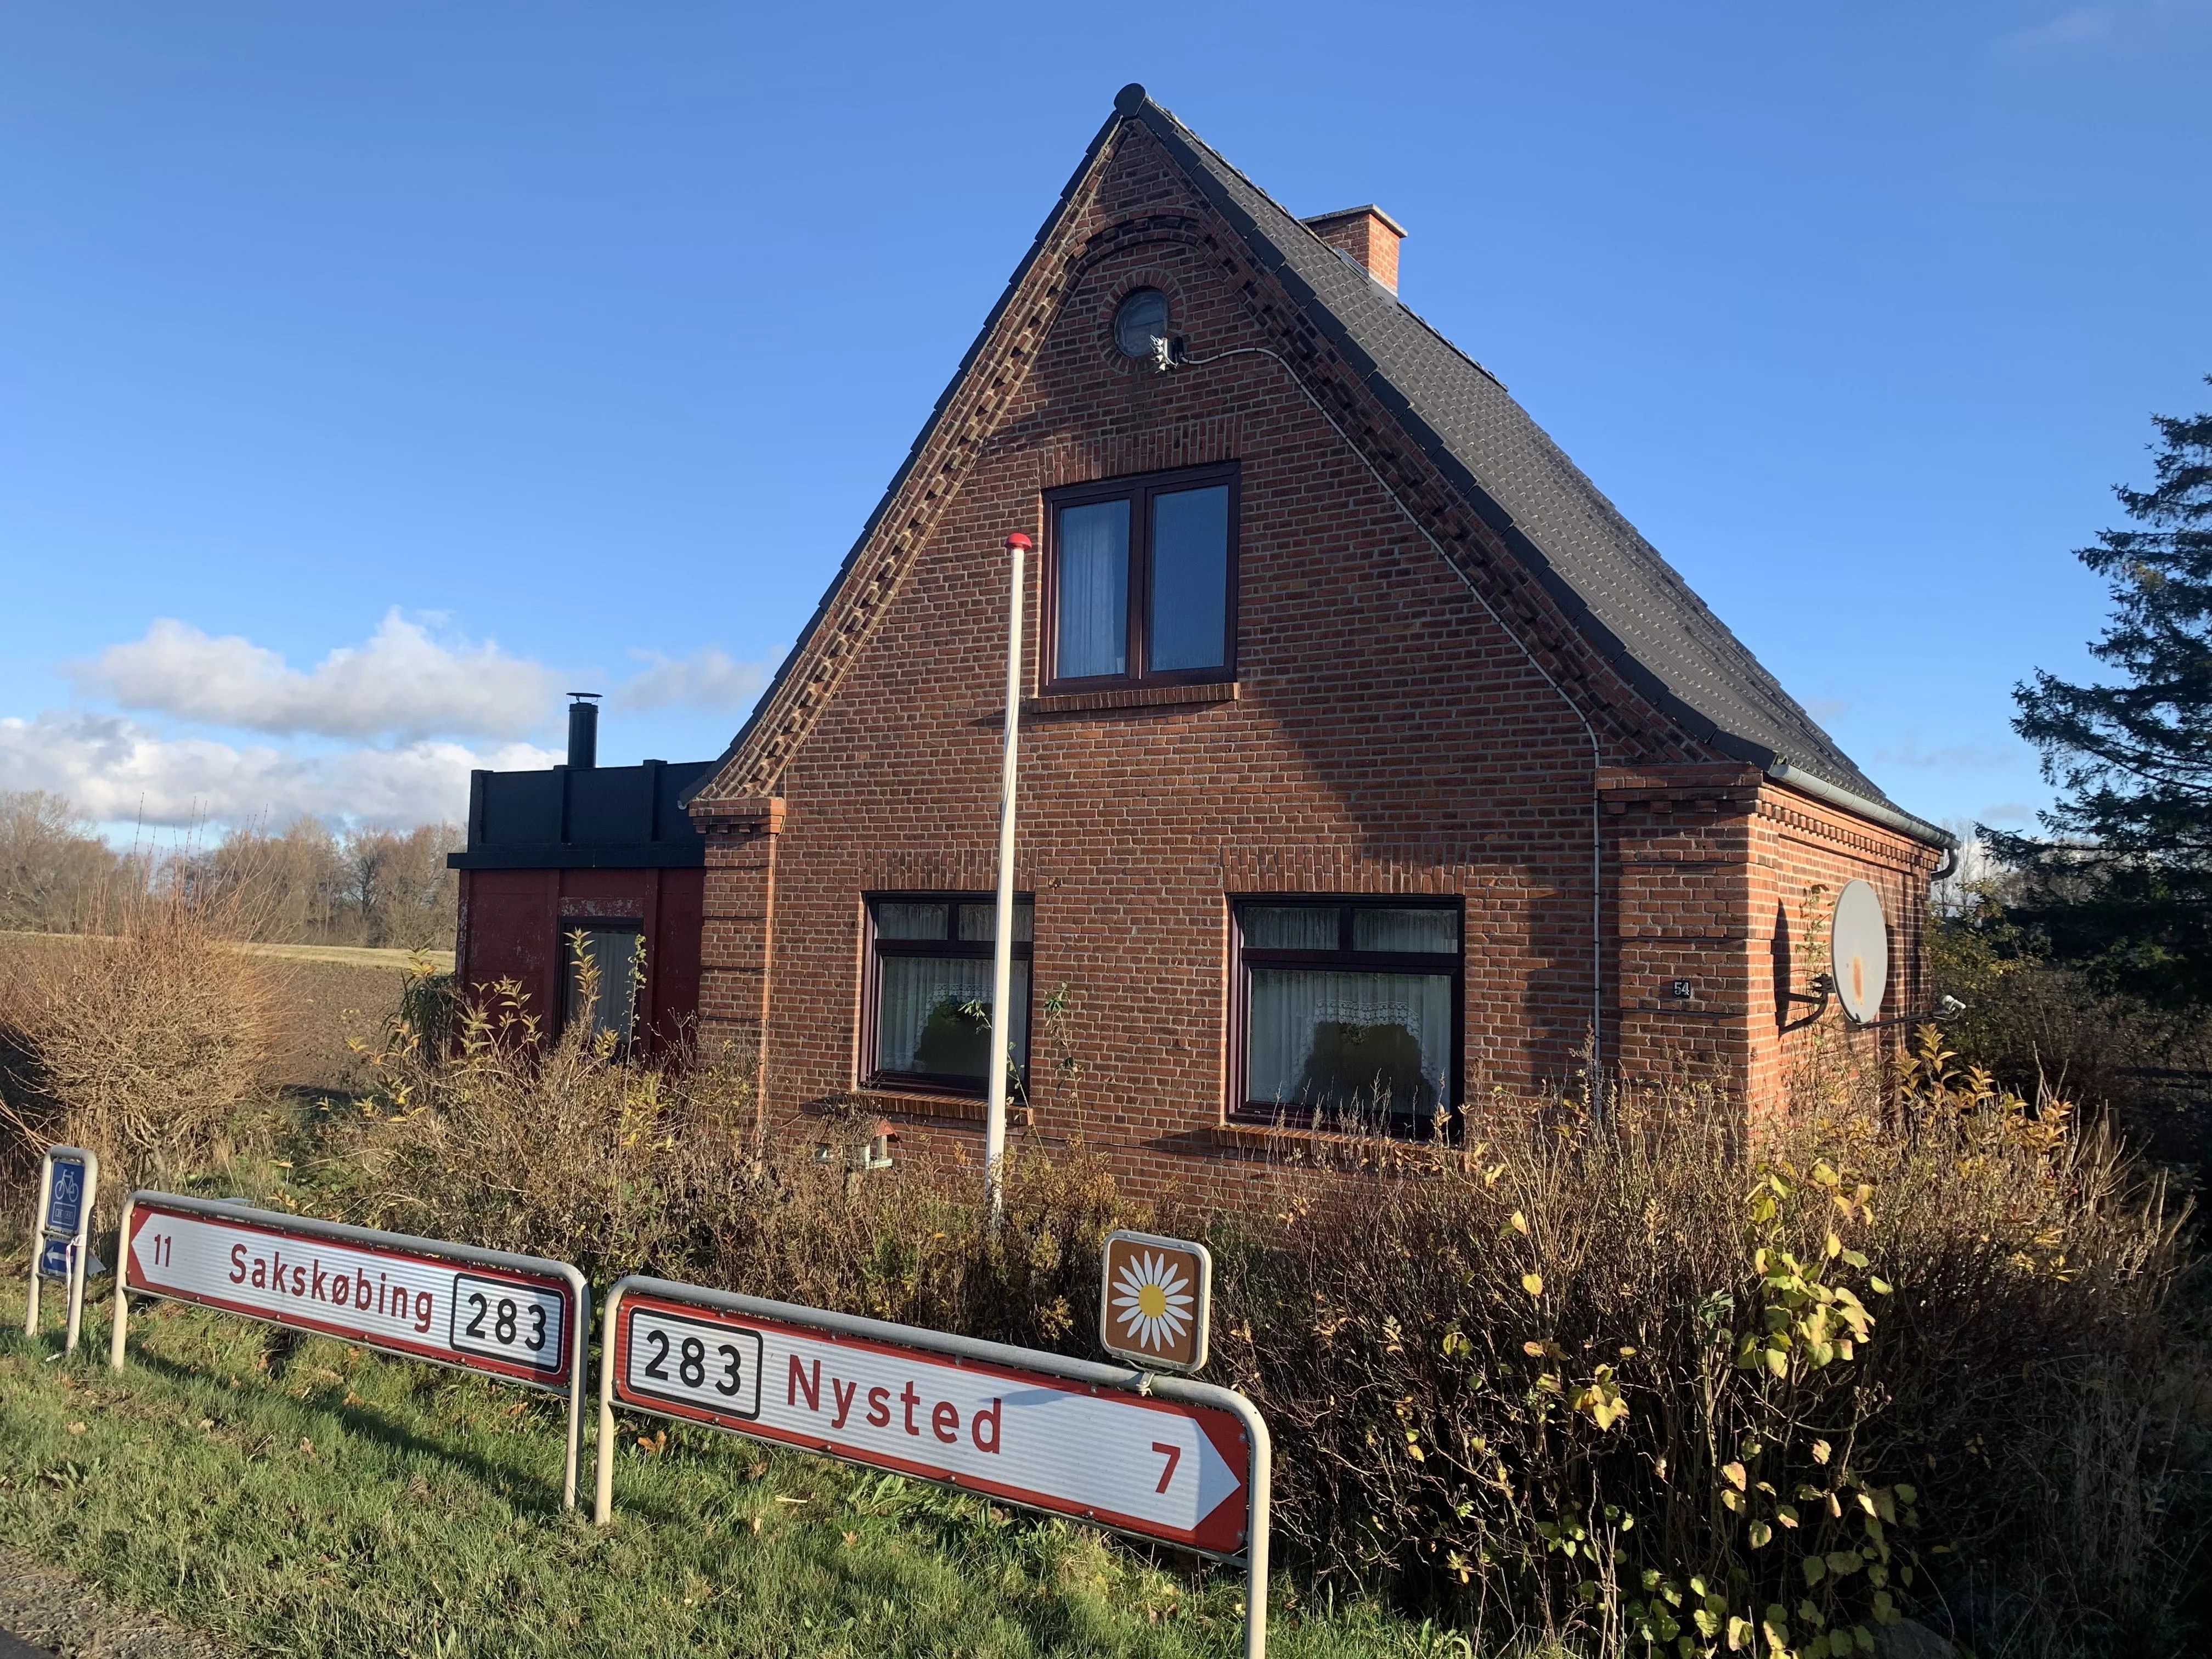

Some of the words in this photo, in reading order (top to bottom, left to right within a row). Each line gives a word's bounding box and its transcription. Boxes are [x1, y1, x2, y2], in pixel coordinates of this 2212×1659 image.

[1674, 982, 1690, 996] 54
[154, 1234, 171, 1267] 11
[229, 1243, 433, 1333] Sakskøbing
[466, 1293, 546, 1351] 283
[645, 1329, 741, 1396] 283
[787, 1354, 1001, 1454] Nysted
[1152, 1441, 1181, 1494] 7
